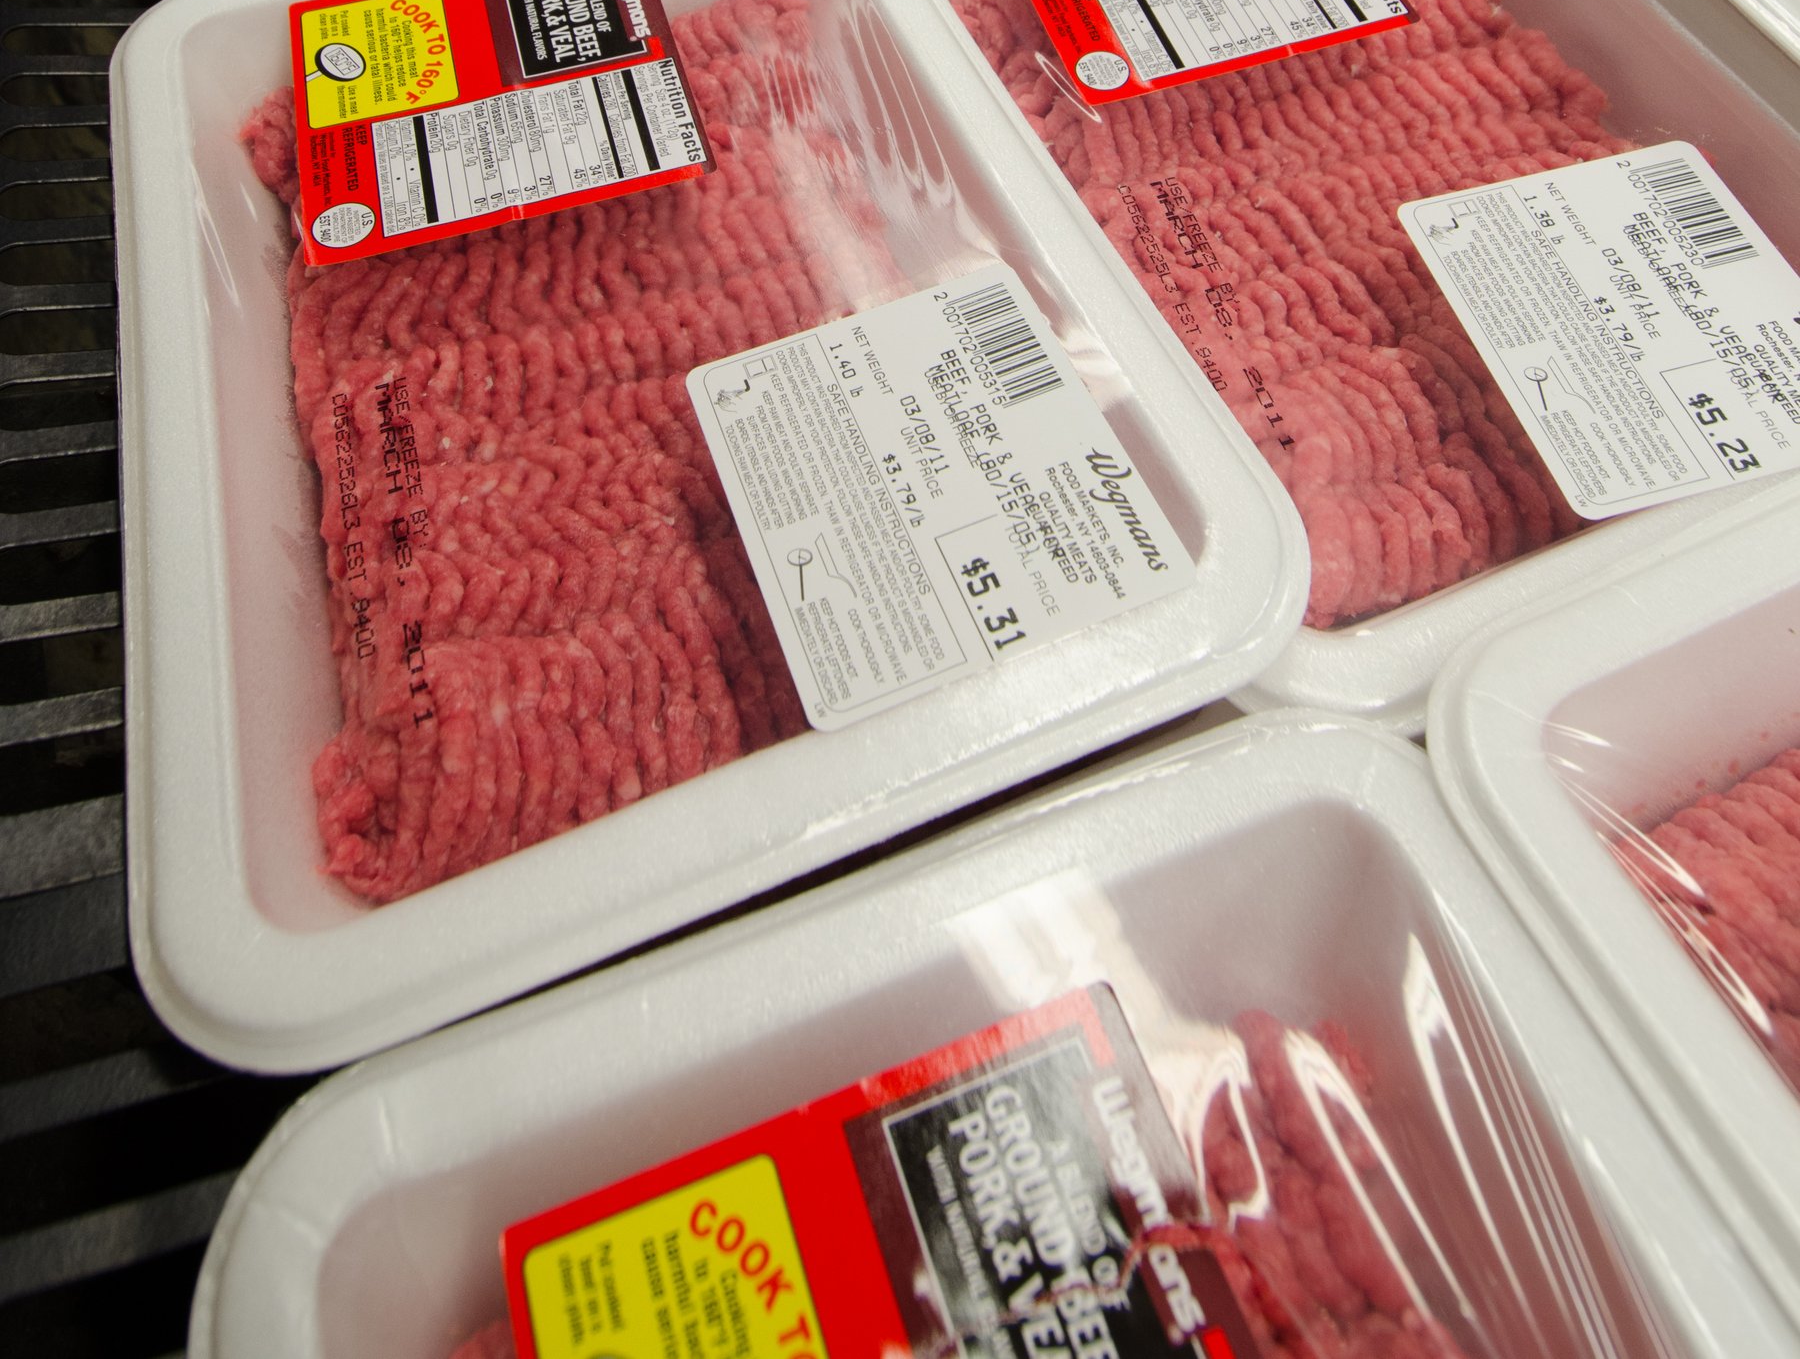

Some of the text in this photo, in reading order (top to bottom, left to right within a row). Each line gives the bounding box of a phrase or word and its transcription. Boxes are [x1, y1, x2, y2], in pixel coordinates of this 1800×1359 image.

[378, 33, 391, 60] bacteria
[401, 19, 418, 78] Cooking this meat
[427, 33, 446, 55] TO
[524, 2, 540, 31] NATURAL
[531, 31, 547, 60] FLAVORS
[547, 24, 577, 62] VEAL
[568, 23, 602, 62] BEEF,
[595, 20, 611, 34] OF
[382, 61, 394, 81] which
[385, 81, 397, 102] could
[391, 44, 407, 87] helps reduce
[355, 123, 367, 145] KEEP
[425, 111, 440, 139] Protein
[472, 101, 496, 170] Total Carbohydrate
[503, 92, 521, 121] Sodium
[552, 88, 586, 188] Saturated 45%
[566, 80, 604, 184] Total Fat 34%
[657, 59, 704, 163] Nutrition Facts
[341, 126, 358, 192] REFRIGERATED
[519, 89, 554, 196] Cholesterol 27%
[361, 211, 372, 228] U.S.
[1523, 195, 1567, 245] 1.38 lb
[1543, 181, 1598, 247] NET WEIGHT
[1625, 173, 1669, 217] 001702
[1661, 219, 1706, 266] 005230
[1599, 247, 1661, 319] 03/08/11
[1631, 211, 1673, 253] BEEF,
[1669, 262, 1707, 299] PORK
[1703, 307, 1721, 317] &
[1150, 181, 1204, 269] MARCH
[1242, 367, 1295, 451] 2011
[1529, 229, 1665, 420] SAFE HANDLING INSTRUCTIONS
[1590, 295, 1647, 362] $3.79/lb
[1607, 273, 1663, 339] UNIT PRICE
[1767, 320, 1794, 346] FOOD
[828, 341, 865, 398] 1.40 lb
[851, 325, 895, 397] NET WEIGHT
[933, 291, 1007, 407] 2 001702 005315
[1752, 344, 1793, 388] QUALITY
[898, 393, 950, 475] 03/08/11
[939, 348, 975, 396] BEEF,
[969, 403, 1002, 445] PORK
[996, 452, 1013, 466] &
[1684, 391, 1761, 474] $5.23
[1755, 410, 1791, 449] PRICE
[825, 382, 932, 597] SAFE HANDLING INSTRUCTIONS
[879, 451, 927, 529] $3.79/lb
[898, 424, 945, 499] UNIT PRICE
[1036, 490, 1097, 585] QUALITY MEATS
[1057, 461, 1127, 568] FOOD MARKETS, INC.
[1079, 447, 1168, 572] Wegmans
[375, 383, 403, 495] MARCH
[402, 620, 433, 729] 2011
[1074, 520, 1092, 538] NY
[1084, 538, 1126, 600] 14603-0844
[955, 554, 1027, 651] $5.31
[1027, 569, 1061, 617] PRICE
[984, 1085, 1075, 1268] GROUND
[688, 1199, 795, 1314] COOK
